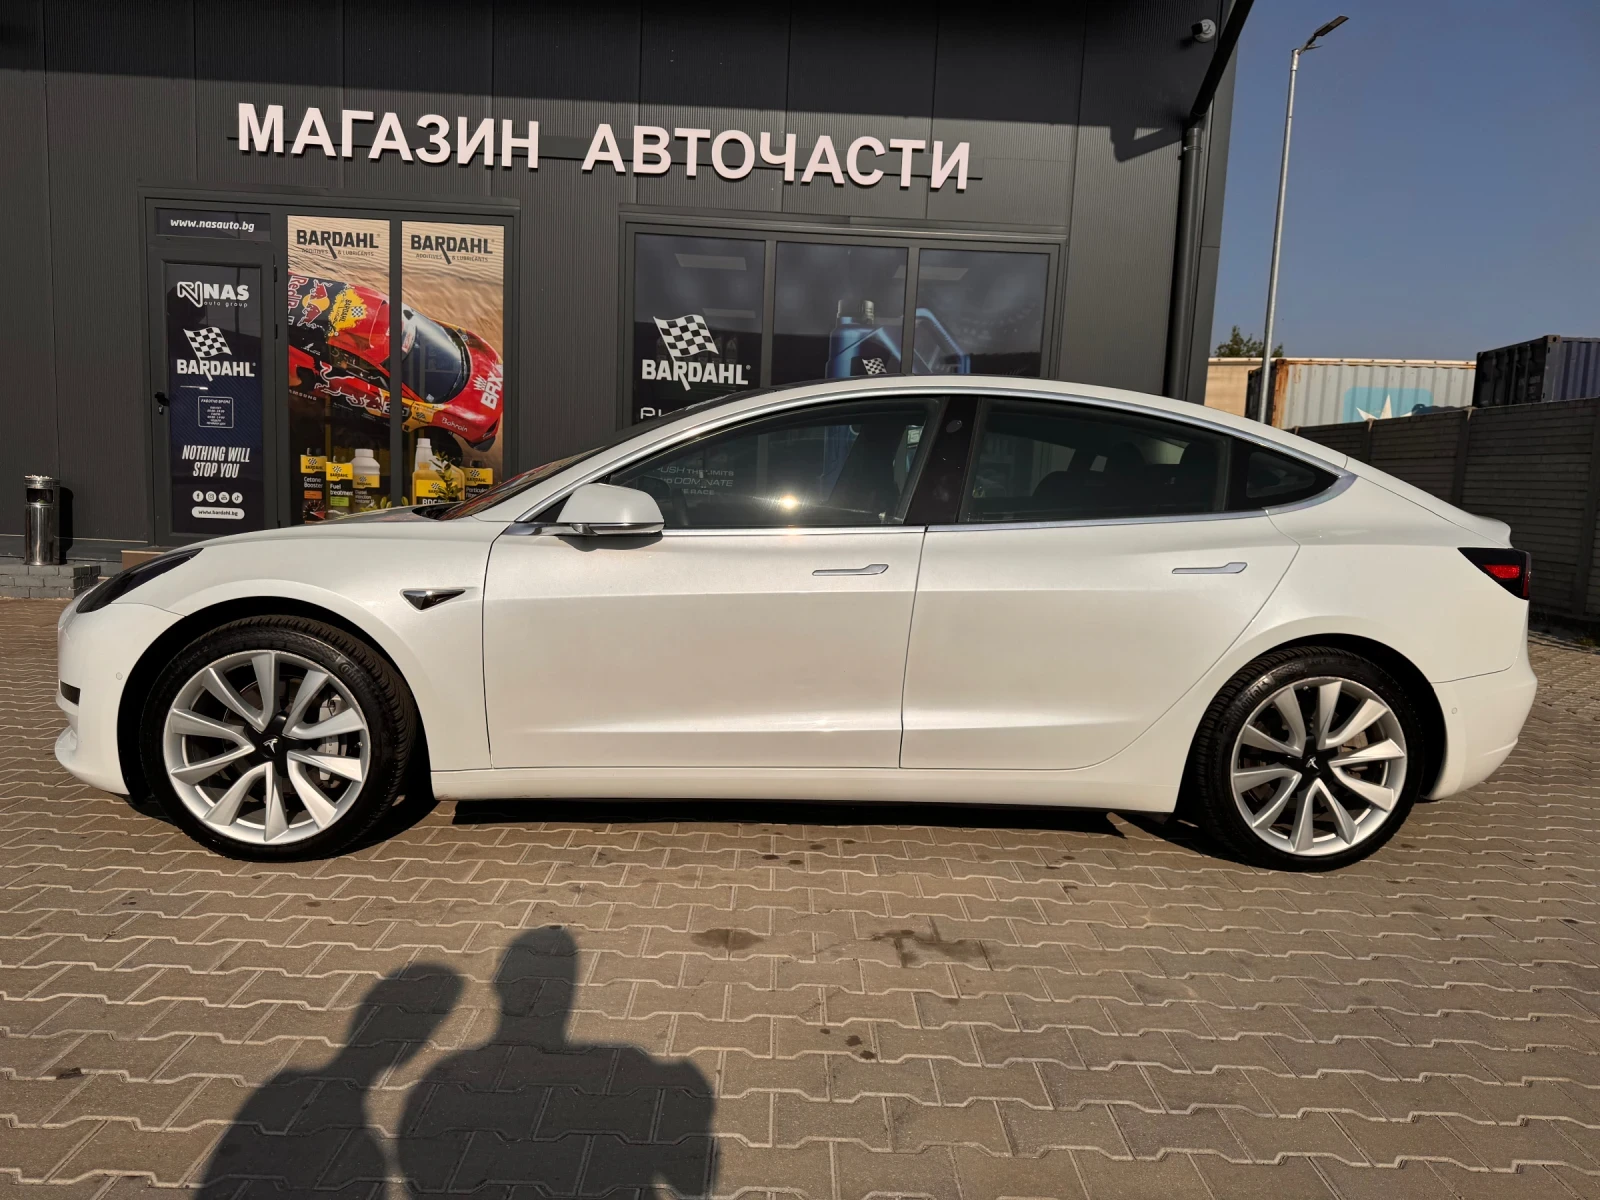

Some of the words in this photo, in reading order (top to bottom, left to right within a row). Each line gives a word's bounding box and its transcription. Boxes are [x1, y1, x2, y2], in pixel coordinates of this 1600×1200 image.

[238, 102, 539, 169] МАГАЗИН
[581, 123, 970, 191] АВТОЧАСТИ
[170, 219, 255, 232] www.nasauto.bg
[296, 229, 379, 259] BARDAHL
[411, 234, 493, 265] BARDAHL
[203, 283, 249, 300] NAS
[176, 358, 255, 382] BARDAHL
[641, 359, 749, 391] BARDAHL
[442, 417, 468, 432] Bahrain
[182, 445, 226, 461] NOTHING
[227, 447, 250, 462] WILL
[193, 462, 218, 477] STOP
[220, 463, 240, 478] YOU
